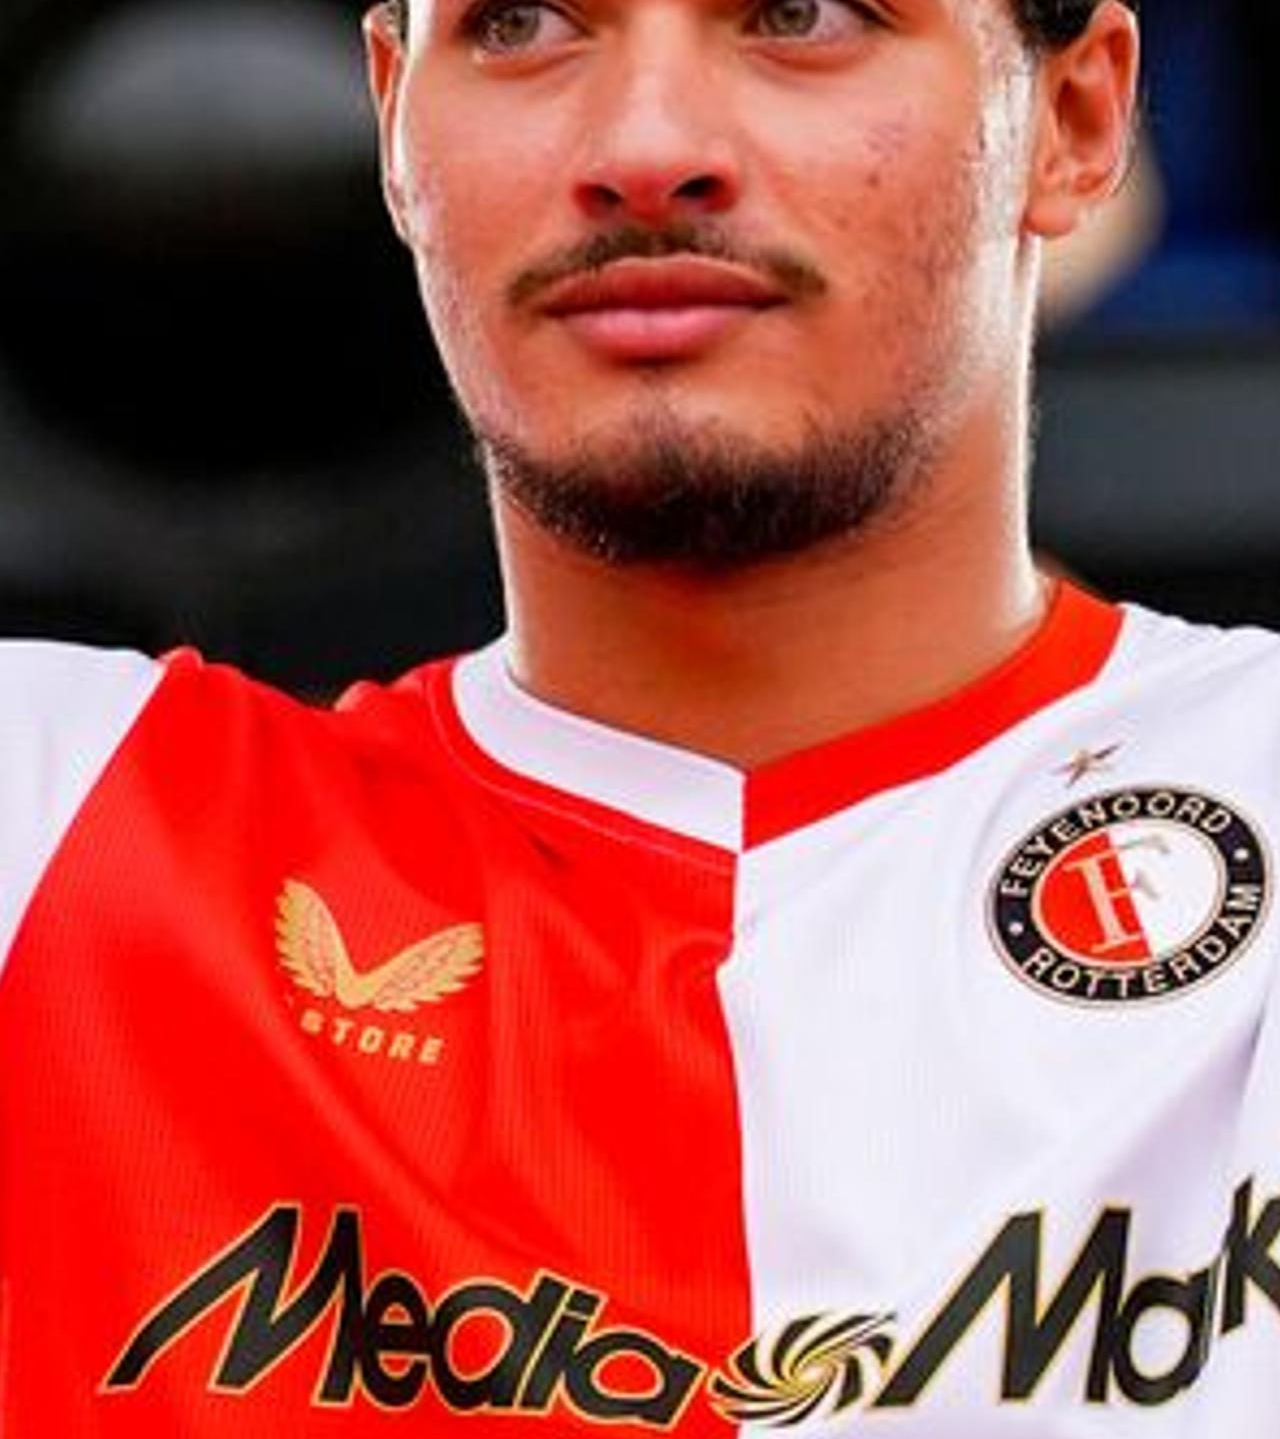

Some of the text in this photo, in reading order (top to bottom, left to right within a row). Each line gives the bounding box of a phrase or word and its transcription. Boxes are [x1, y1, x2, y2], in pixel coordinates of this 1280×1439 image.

[1001, 791, 1231, 897] FEYENOORD
[1023, 883, 1263, 998] ROTTERDAM
[98, 1200, 708, 1431] Media
